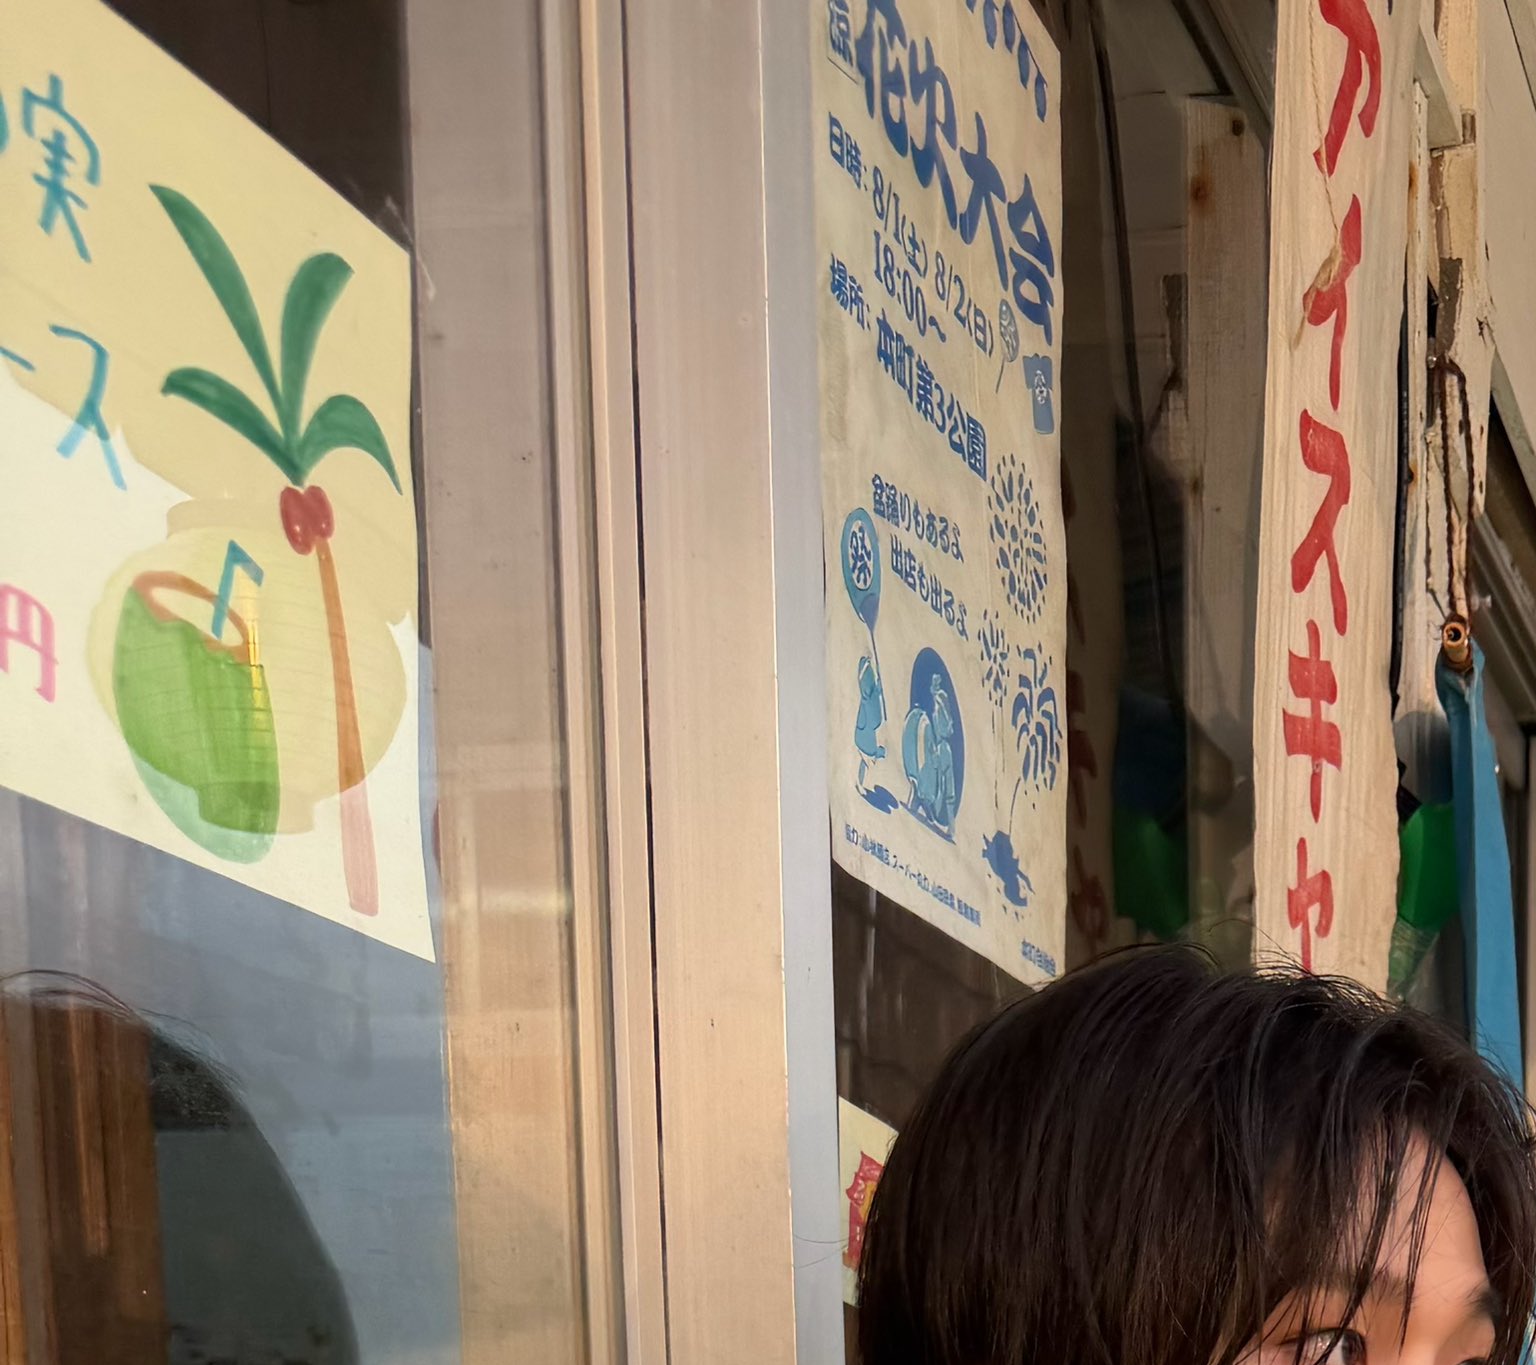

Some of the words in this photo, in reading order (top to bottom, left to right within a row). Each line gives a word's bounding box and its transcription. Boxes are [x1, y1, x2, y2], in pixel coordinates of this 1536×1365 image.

[0, 73, 101, 264] 実
[889, 533, 970, 643] 出店も出るよ
